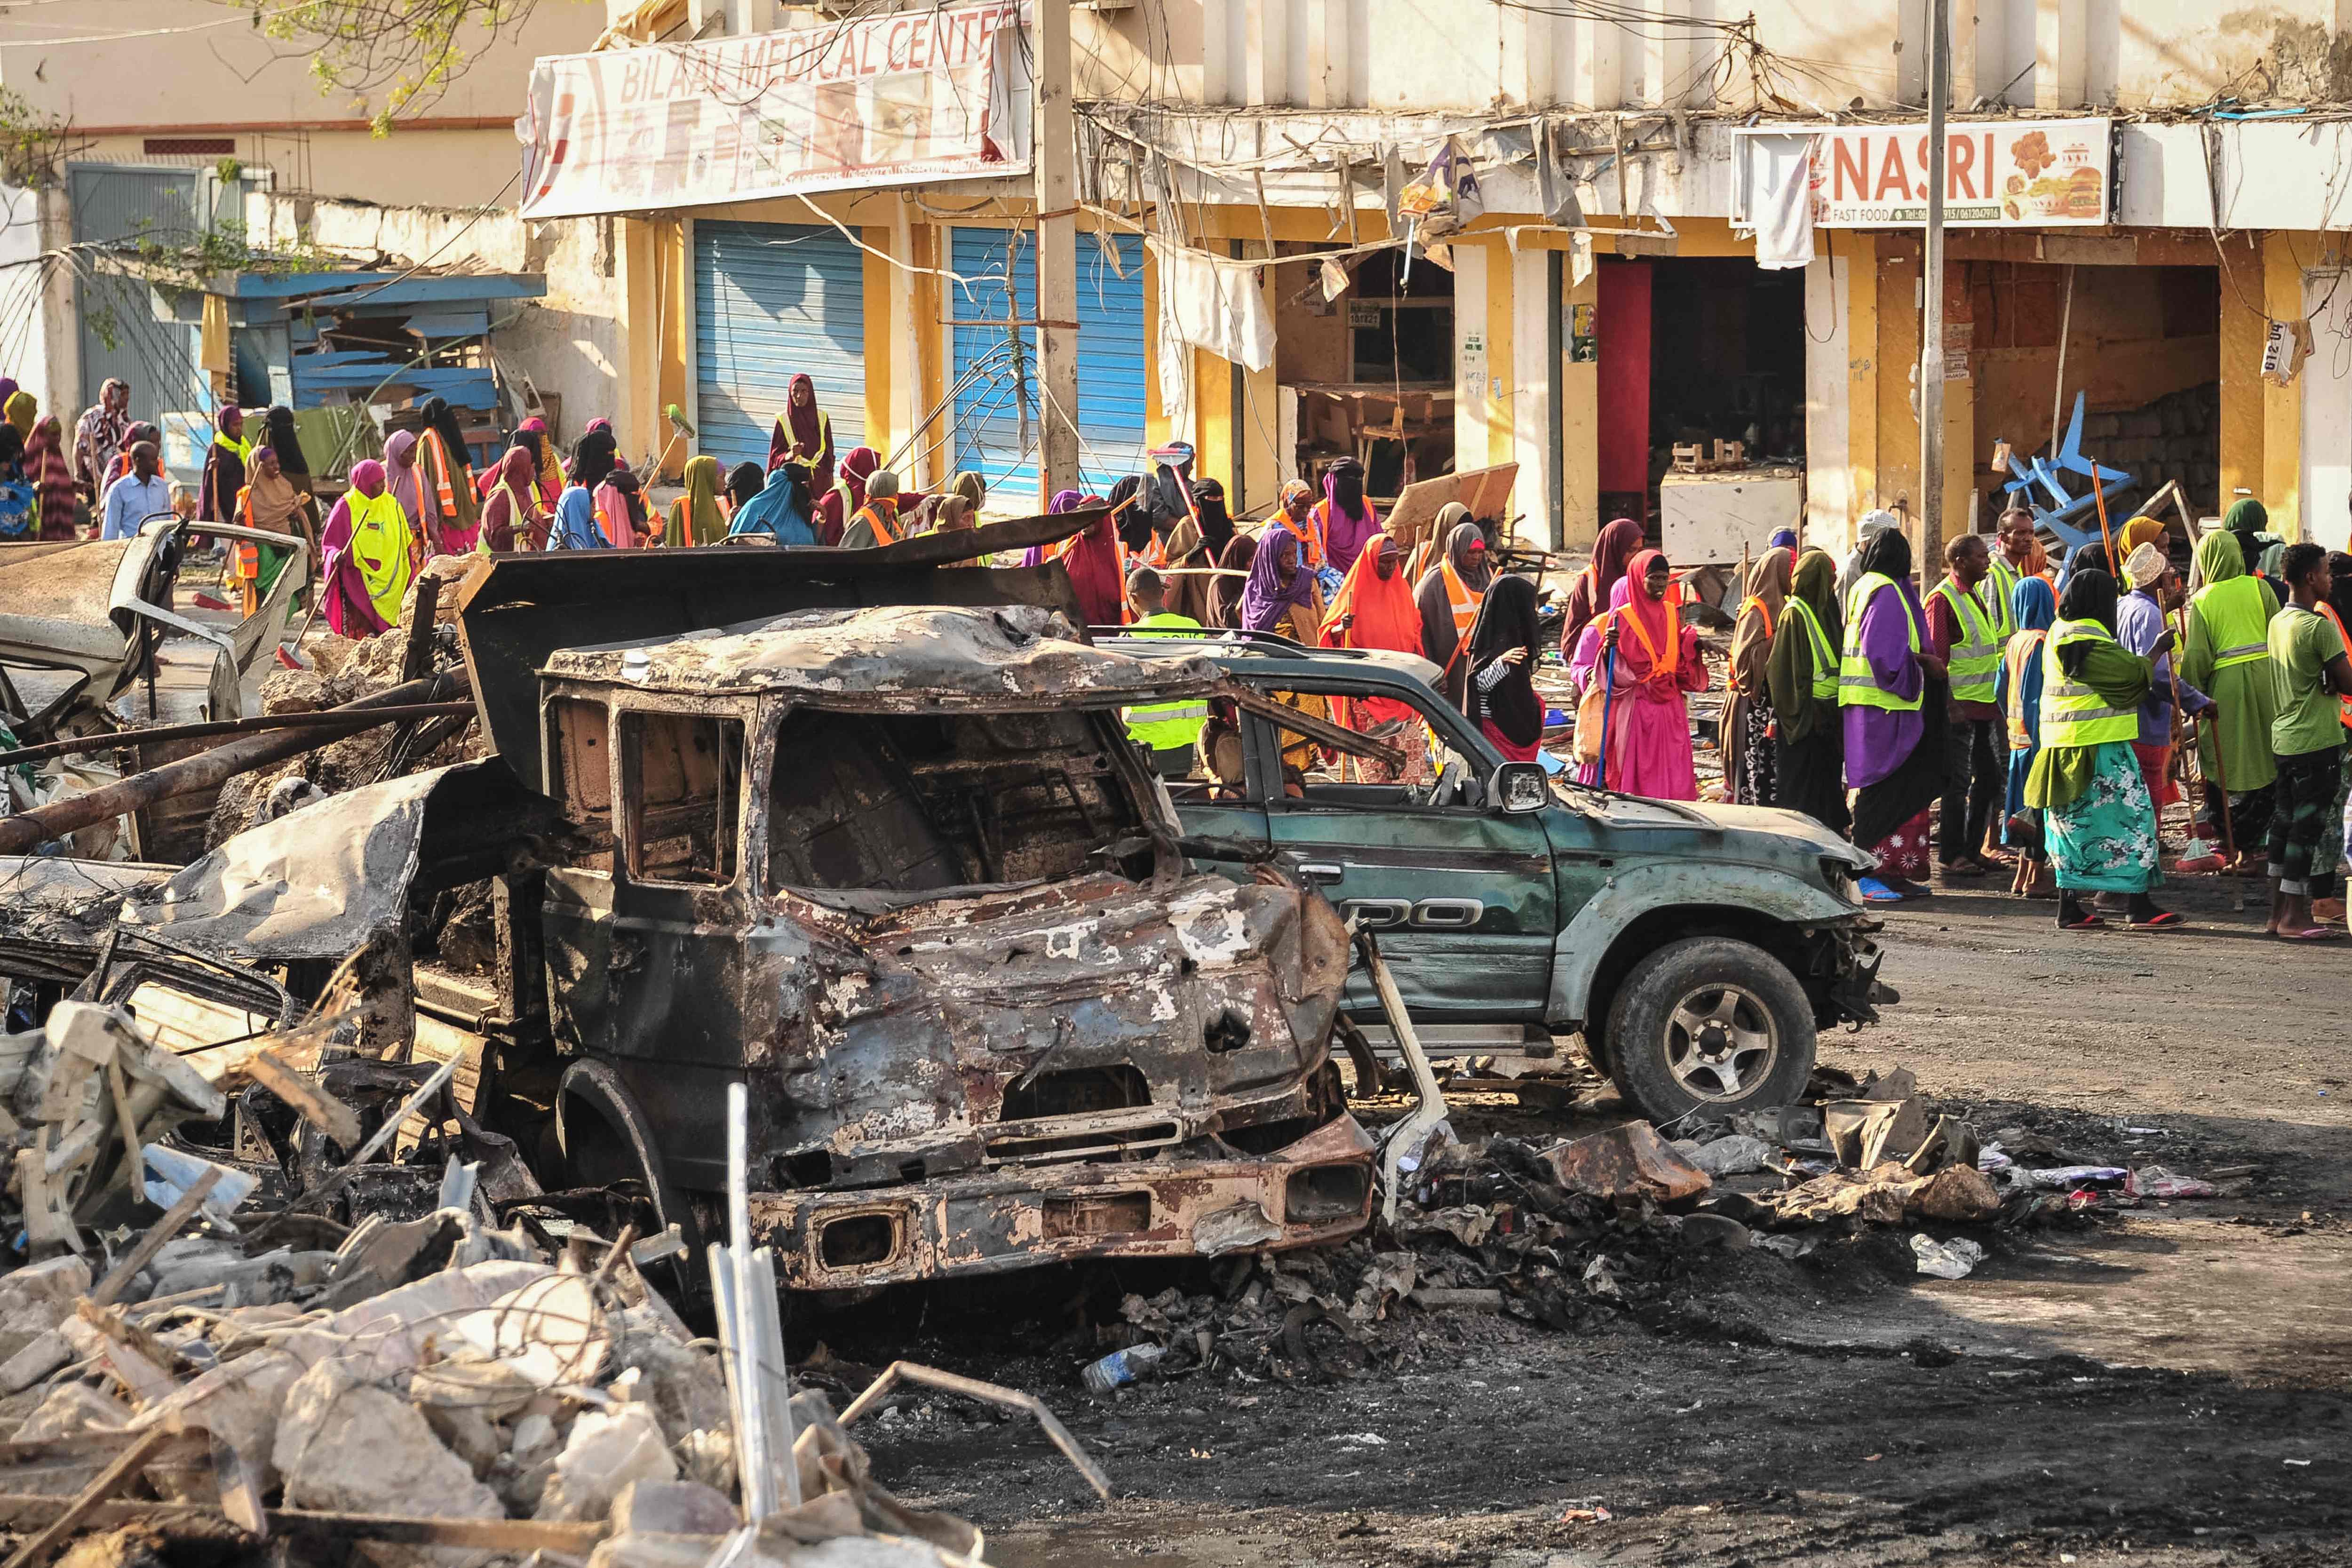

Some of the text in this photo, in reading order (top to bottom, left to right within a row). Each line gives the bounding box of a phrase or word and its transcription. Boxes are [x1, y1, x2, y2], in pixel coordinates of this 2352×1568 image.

[620, 8, 1012, 103] BILAAL MEDICAL CENTE
[1834, 208, 1856, 221] FAST
[1861, 208, 1889, 221] FOOD
